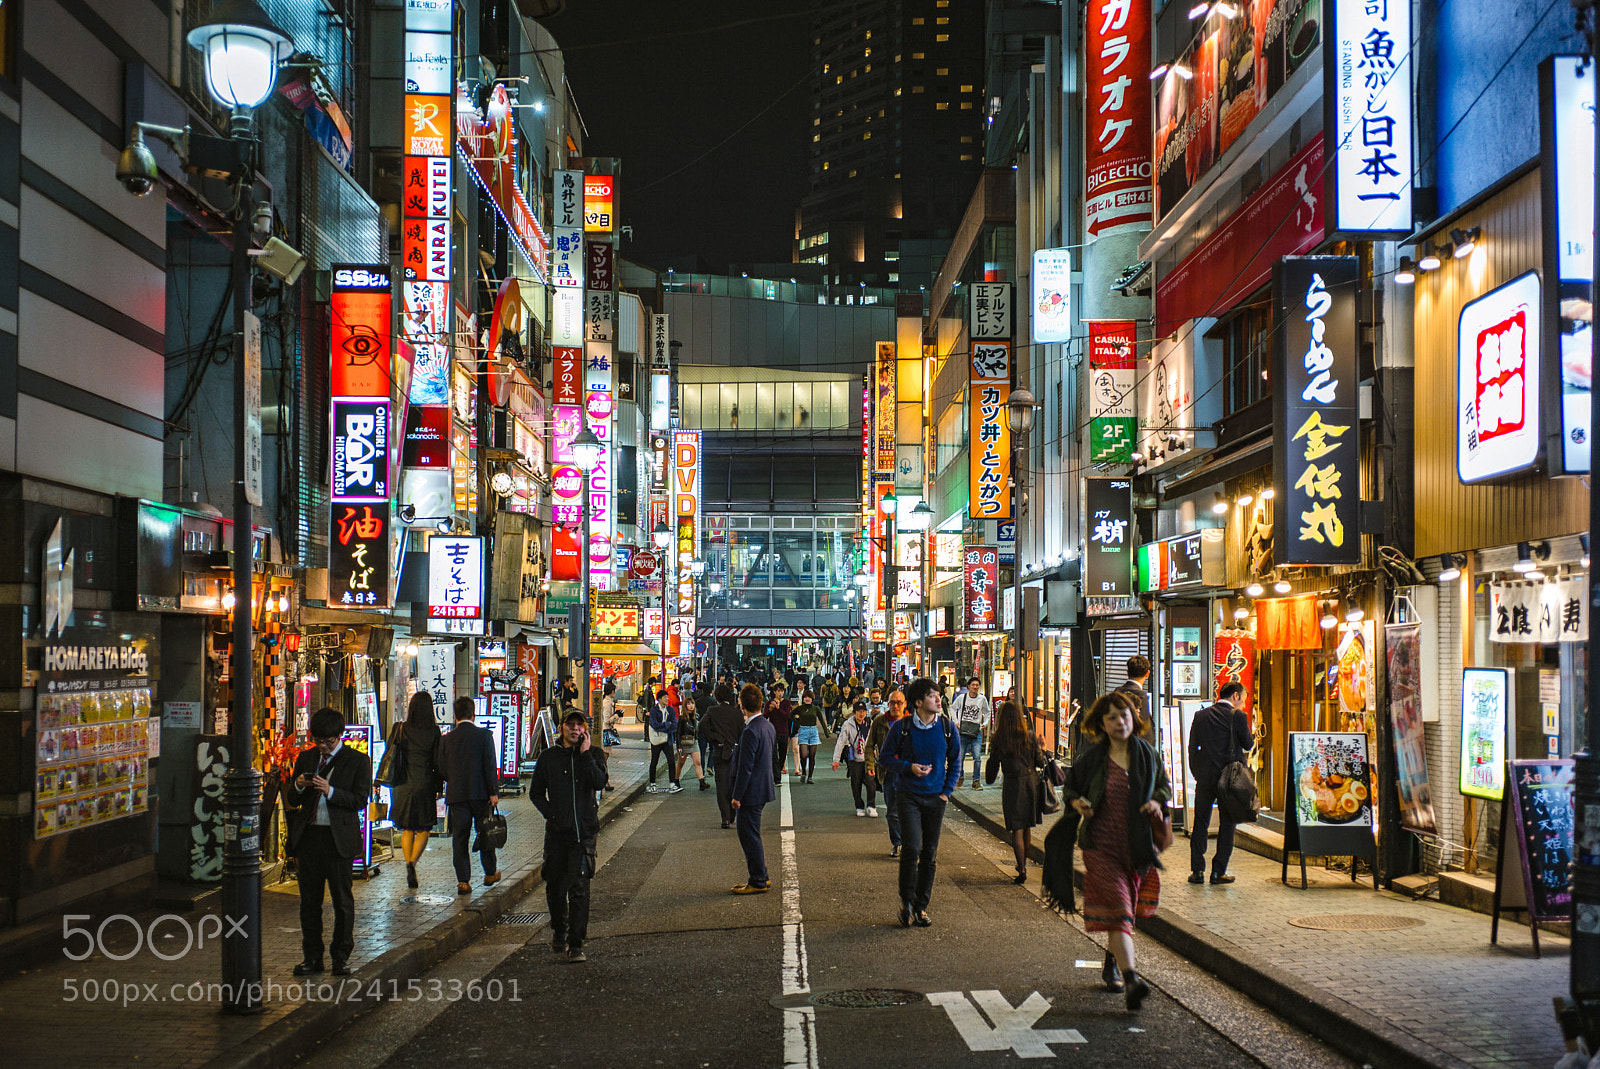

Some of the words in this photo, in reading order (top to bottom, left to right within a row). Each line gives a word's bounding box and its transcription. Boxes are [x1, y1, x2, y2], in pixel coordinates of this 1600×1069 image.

[1099, 0, 1132, 153] カラオケ
[1342, 40, 1351, 89] STANDING
[407, 82, 417, 92] 5F
[1343, 96, 1351, 124] SUSHI
[1088, 170, 1107, 192] BIG
[1109, 162, 1152, 180] ECHO
[1087, 199, 1113, 217] 正面ビル
[335, 269, 390, 288] SSビル
[405, 267, 417, 279] 3F
[976, 285, 989, 336] 正実ビル
[1094, 336, 1132, 345] CASUAL
[1301, 272, 1339, 404] らーめん
[560, 348, 576, 397] バラの木
[588, 355, 611, 371] 梅
[375, 406, 386, 446] ONIGIRI
[1103, 424, 1124, 438] 2F
[979, 386, 1001, 515] カツ丼・とんかつ
[334, 436, 345, 496] HIROMATSU
[677, 444, 697, 516] DVD
[374, 481, 385, 496] 2F
[338, 506, 383, 590] 油そば
[1101, 581, 1116, 591] B1
[433, 606, 476, 617] 24h営業
[45, 645, 119, 671] HOMAREYA
[120, 645, 149, 676] Bldg.
